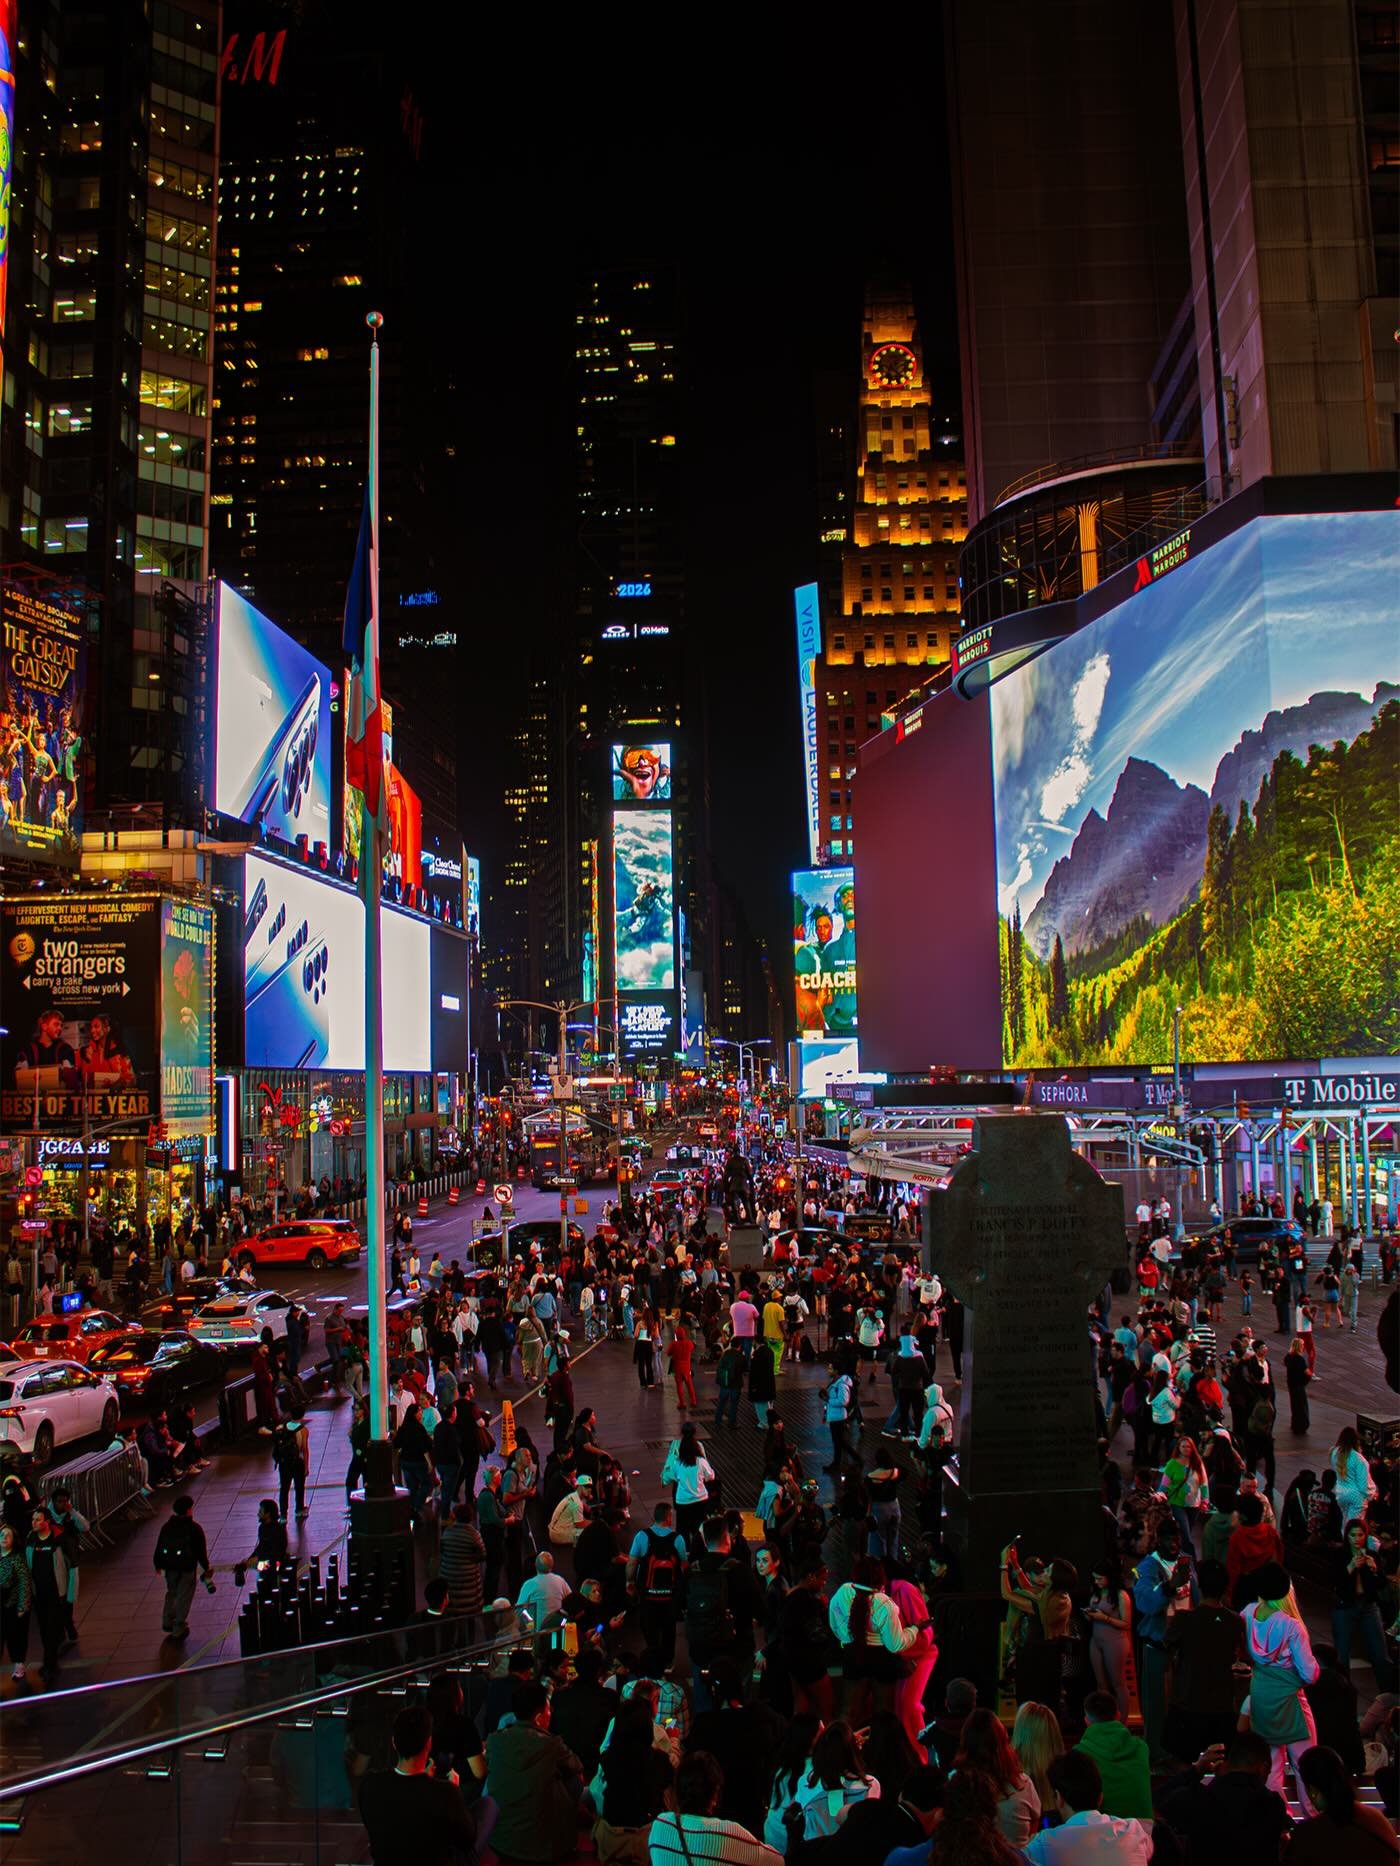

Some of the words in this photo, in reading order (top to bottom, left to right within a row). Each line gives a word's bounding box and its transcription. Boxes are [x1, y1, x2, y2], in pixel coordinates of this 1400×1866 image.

[1153, 529, 1191, 562] MARRIOTT
[1153, 547, 1187, 577] MARQUIS
[618, 583, 651, 597] 2026
[19, 603, 68, 630] EXTRAVAGANZA
[46, 605, 80, 624] BROADWAY
[801, 604, 815, 654] VISIT
[958, 626, 993, 653] MARRIOTT
[3, 621, 29, 653] THE
[32, 635, 79, 670] GREAT
[959, 642, 989, 667] MARQUIS
[12, 652, 69, 690] GATSBY
[330, 701, 339, 712] G
[806, 691, 820, 832] LAUDERDALE
[16, 915, 58, 925] LAUGHTER,
[59, 915, 90, 925] ESCAPE,
[17, 904, 69, 915] EFFERVESCENT
[70, 903, 87, 914] NEW
[88, 903, 120, 913] MUSICAL
[165, 918, 185, 940] WORLD
[185, 924, 203, 944] COULD
[203, 929, 210, 945] BE
[43, 938, 78, 958] two
[35, 956, 126, 980] strangers
[32, 977, 55, 989] carry
[55, 978, 61, 987] a
[62, 975, 83, 987] cake
[52, 984, 81, 995] across
[82, 984, 100, 994] new
[101, 982, 121, 996] york
[800, 970, 857, 990] COACH
[163, 1066, 211, 1095] HADESTOWN
[1151, 1066, 1175, 1075] SEPHORA
[1041, 1086, 1088, 1102] SEPHORA
[1285, 1079, 1306, 1104] T
[1312, 1076, 1396, 1103] Mobile
[46, 1096, 67, 1116] OF
[107, 1095, 149, 1115] YEAR
[913, 1173, 935, 1183] NORTH
